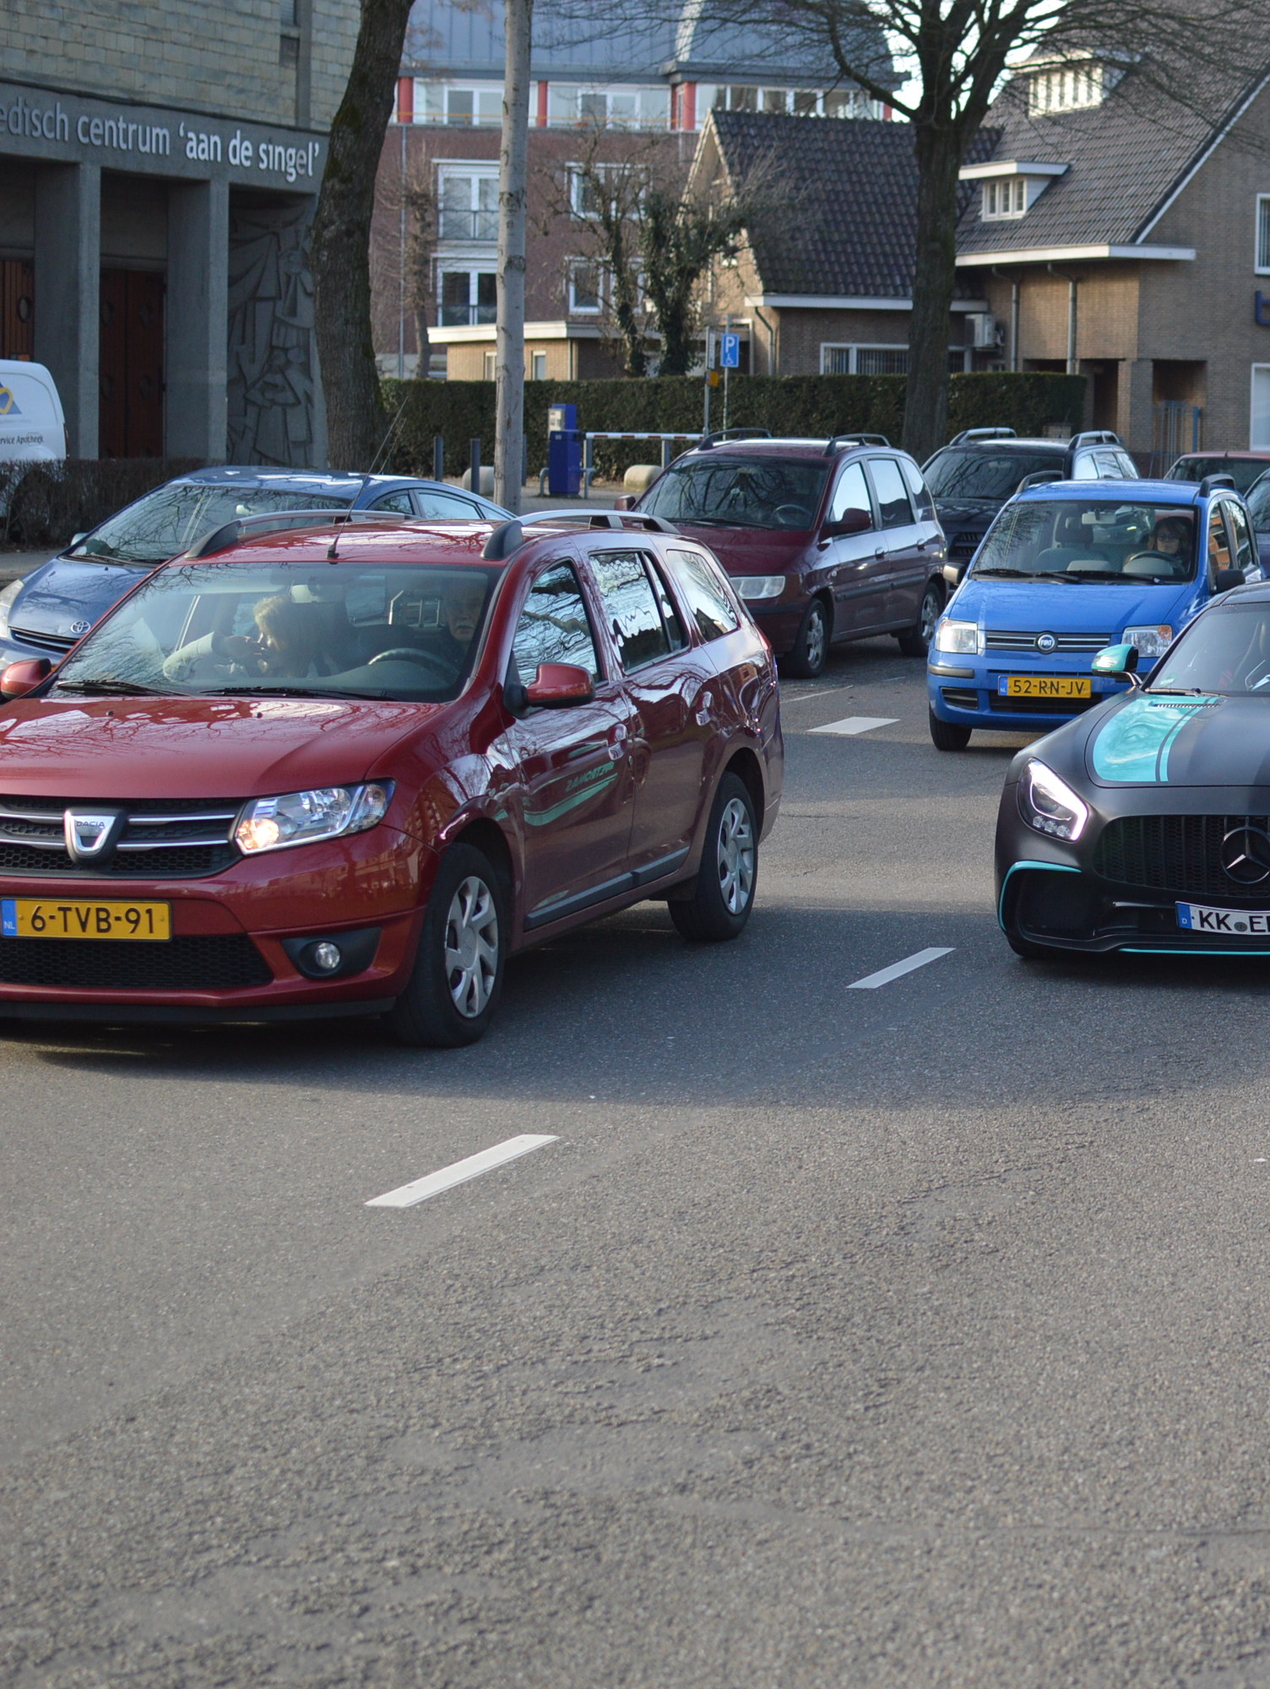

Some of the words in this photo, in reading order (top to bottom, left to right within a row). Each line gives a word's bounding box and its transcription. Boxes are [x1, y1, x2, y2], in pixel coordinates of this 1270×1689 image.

[77, 114, 170, 156] centrum
[228, 129, 253, 168] de
[725, 336, 736, 354] P
[1013, 679, 1085, 695] 52-RN-JV
[4, 921, 15, 930] NL
[31, 905, 154, 934] 6-TVB-91
[1199, 910, 1232, 931] KK
